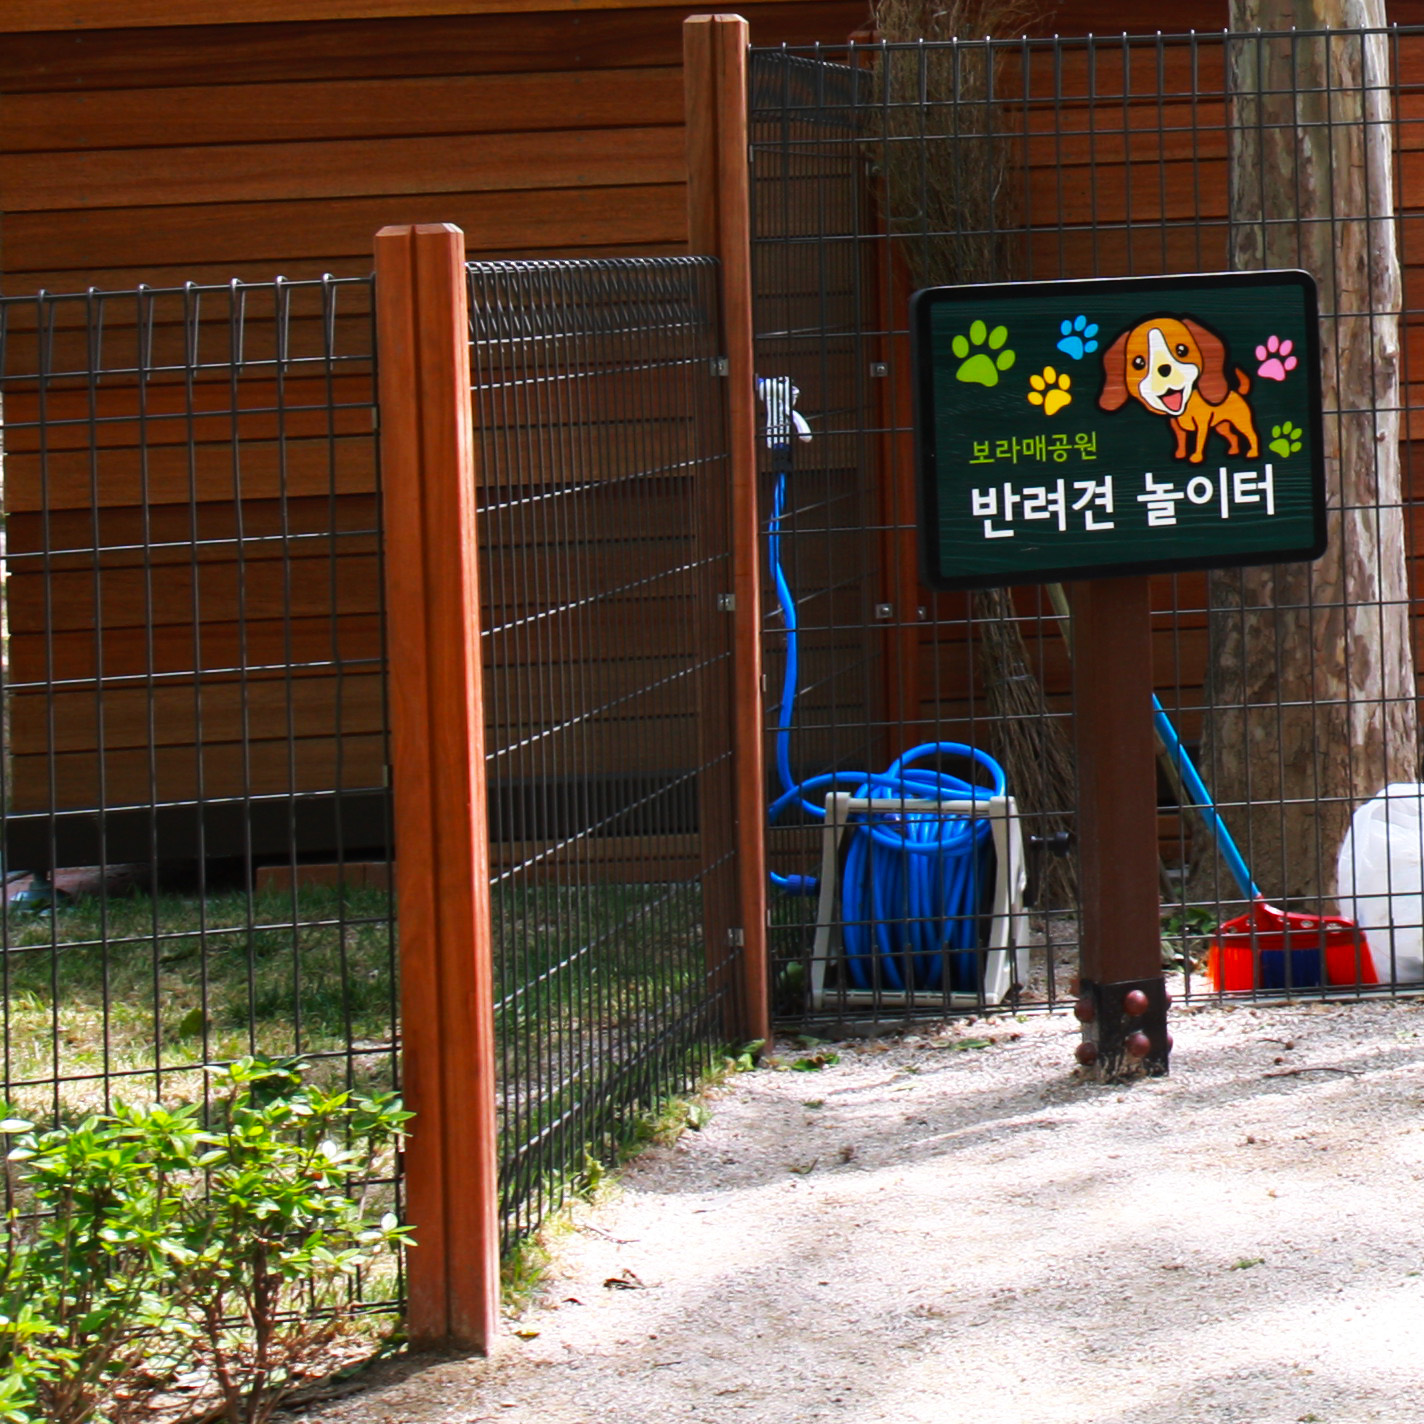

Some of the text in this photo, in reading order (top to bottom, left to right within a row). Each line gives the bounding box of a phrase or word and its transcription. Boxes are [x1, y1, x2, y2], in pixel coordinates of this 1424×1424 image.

[969, 432, 1098, 464] 보라매공원
[971, 464, 1275, 539] 반려견 놀이터
